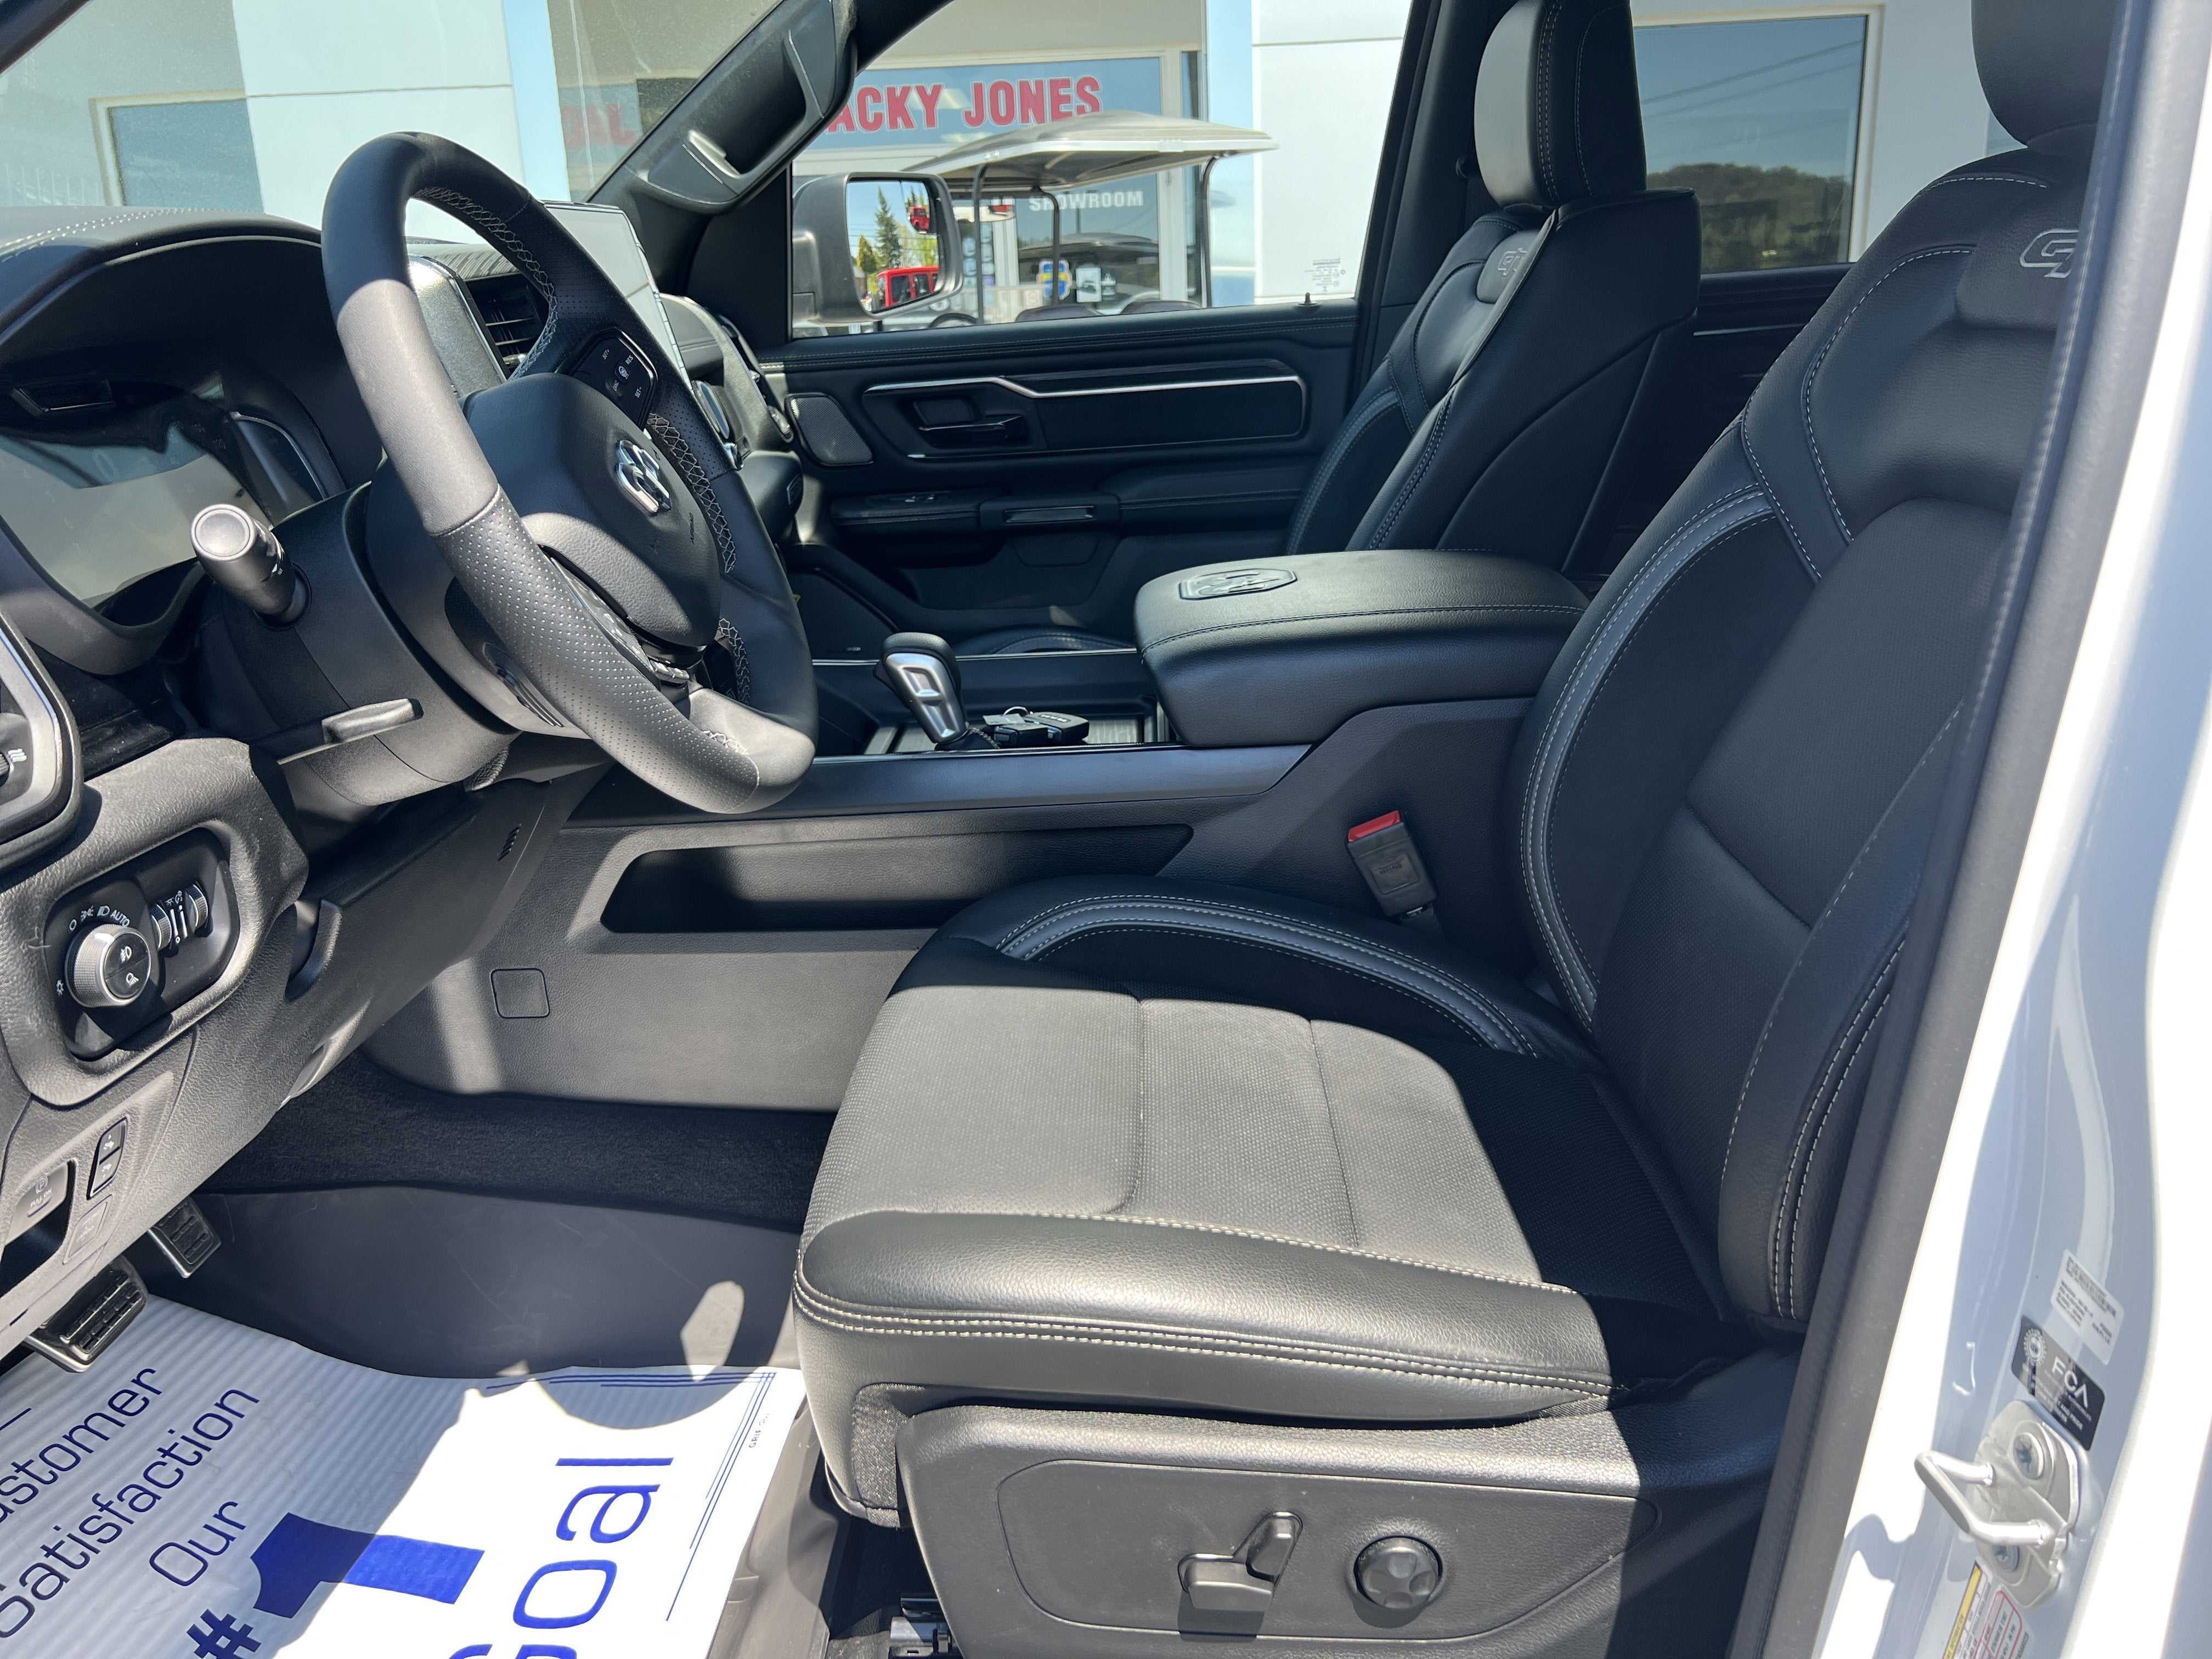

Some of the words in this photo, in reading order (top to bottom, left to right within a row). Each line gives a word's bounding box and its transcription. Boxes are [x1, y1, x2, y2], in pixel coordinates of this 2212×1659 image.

[827, 83, 943, 133] ACKY
[962, 76, 1101, 127] JONES
[1028, 191, 1144, 211] SHOWROOM
[625, 355, 634, 365] RES
[110, 910, 130, 928] AUTO
[43, 1188, 52, 1198] ON
[2052, 1356, 2089, 1409] FCA
[149, 1500, 247, 1587] Our
[447, 1457, 674, 1659] oal
